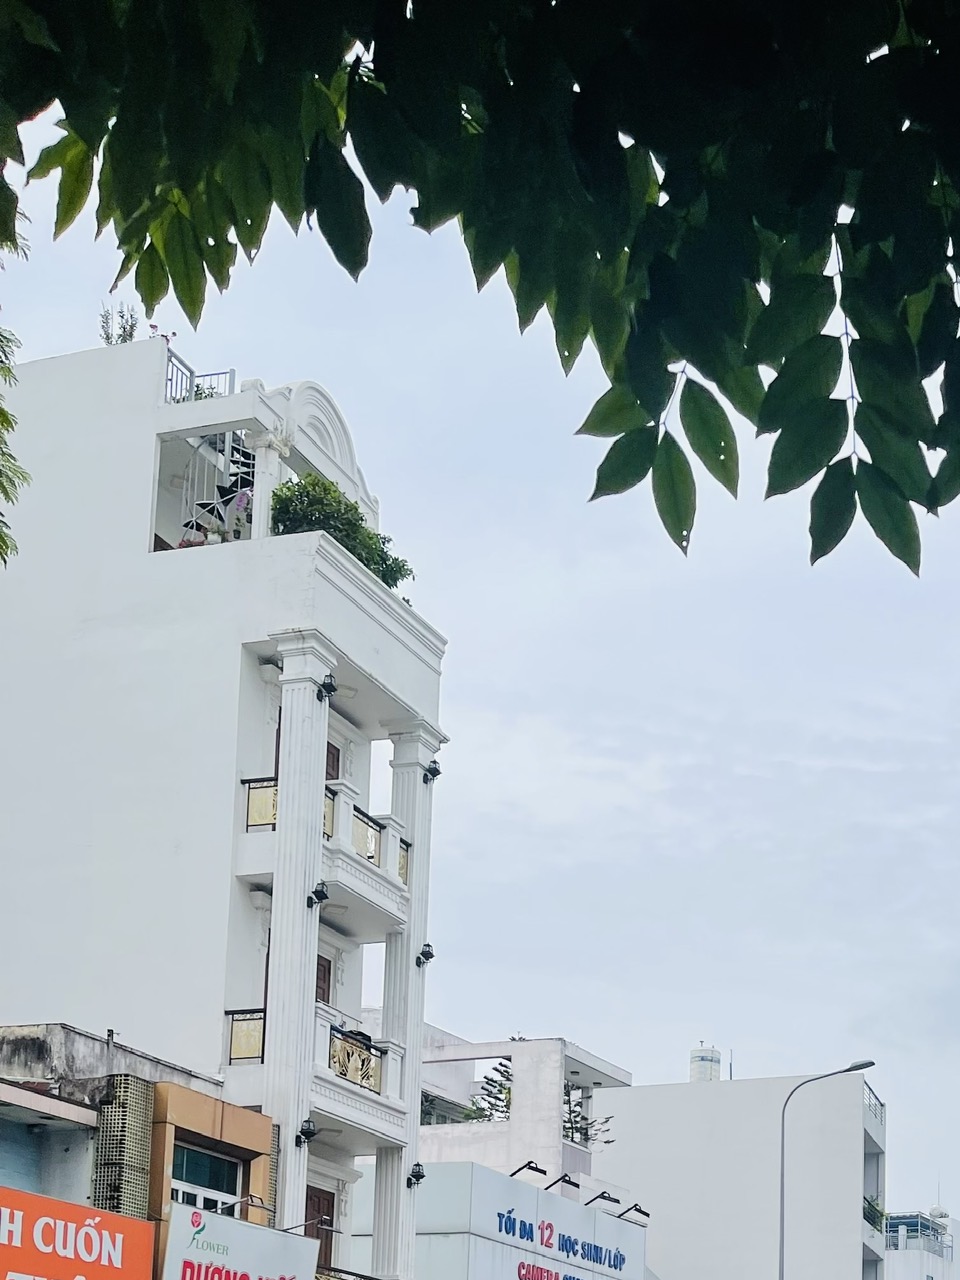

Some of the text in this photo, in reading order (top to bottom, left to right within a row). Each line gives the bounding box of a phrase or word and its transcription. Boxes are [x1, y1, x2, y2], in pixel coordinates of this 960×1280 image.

[33, 1216, 124, 1269] CUỐN
[497, 1208, 516, 1237] TỐI
[538, 1220, 555, 1249] 12
[558, 1233, 579, 1259] HỌC
